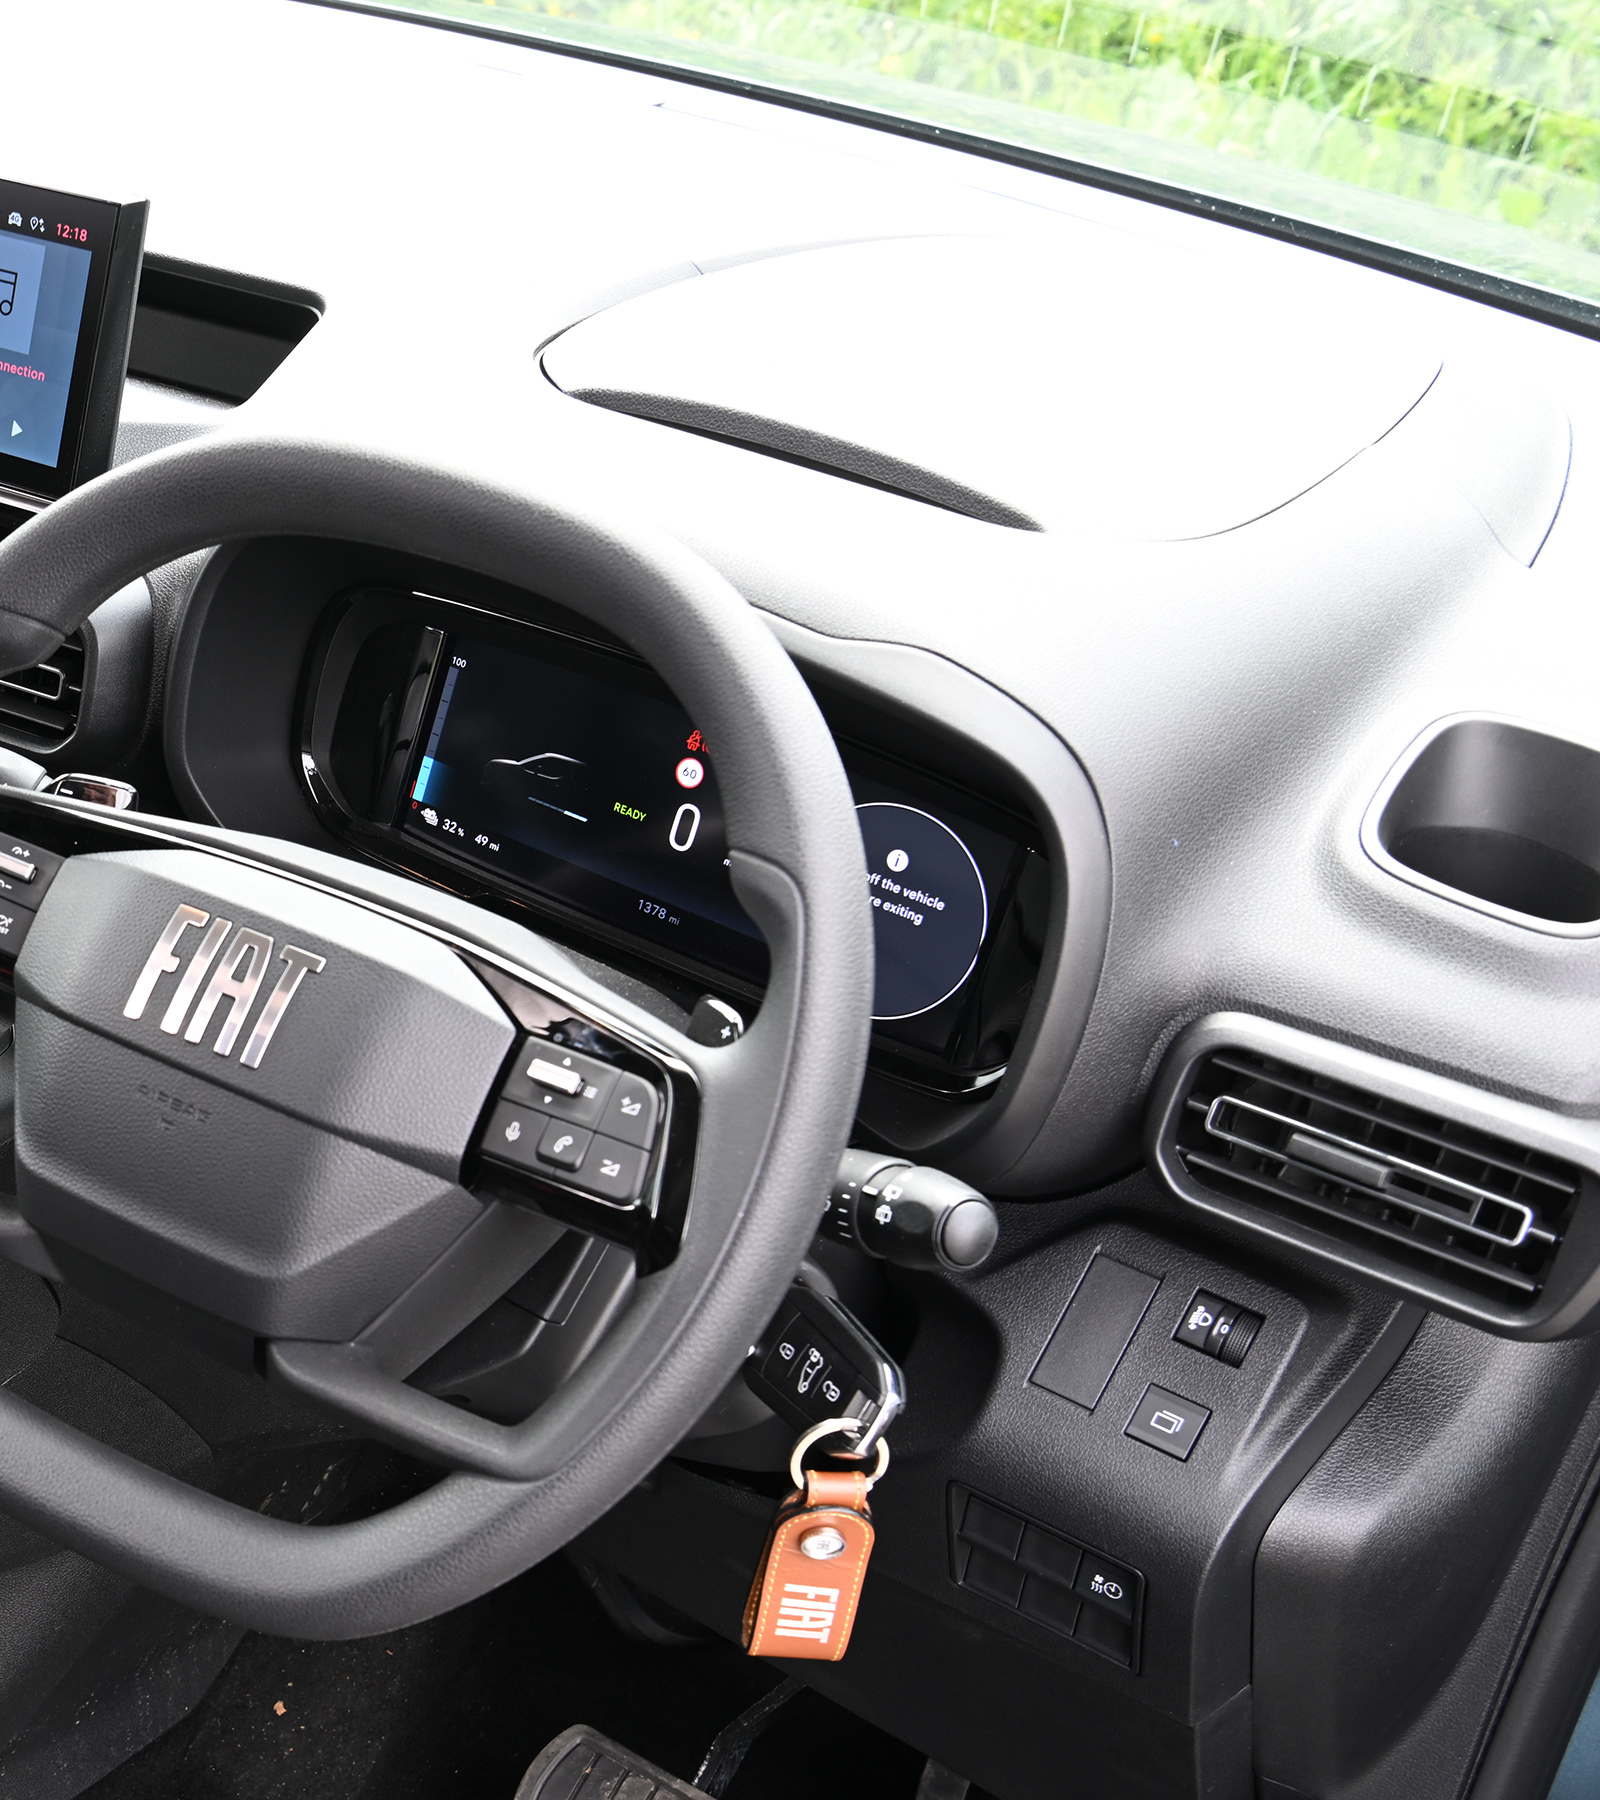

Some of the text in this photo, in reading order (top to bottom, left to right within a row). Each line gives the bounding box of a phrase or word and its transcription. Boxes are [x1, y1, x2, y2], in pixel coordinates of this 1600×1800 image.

[56, 222, 88, 242] 12:18
[452, 656, 467, 669] 100
[682, 766, 698, 780] 60
[411, 801, 418, 810] 0
[613, 801, 648, 822] READY
[668, 802, 701, 852] 0
[474, 834, 500, 852] 49 mi
[881, 877, 902, 894] the
[902, 889, 946, 911] vehicle
[637, 899, 681, 926] 1378 mi
[882, 901, 924, 926] exiting
[123, 903, 327, 1069] FIAT
[774, 1583, 840, 1644] FIAT
